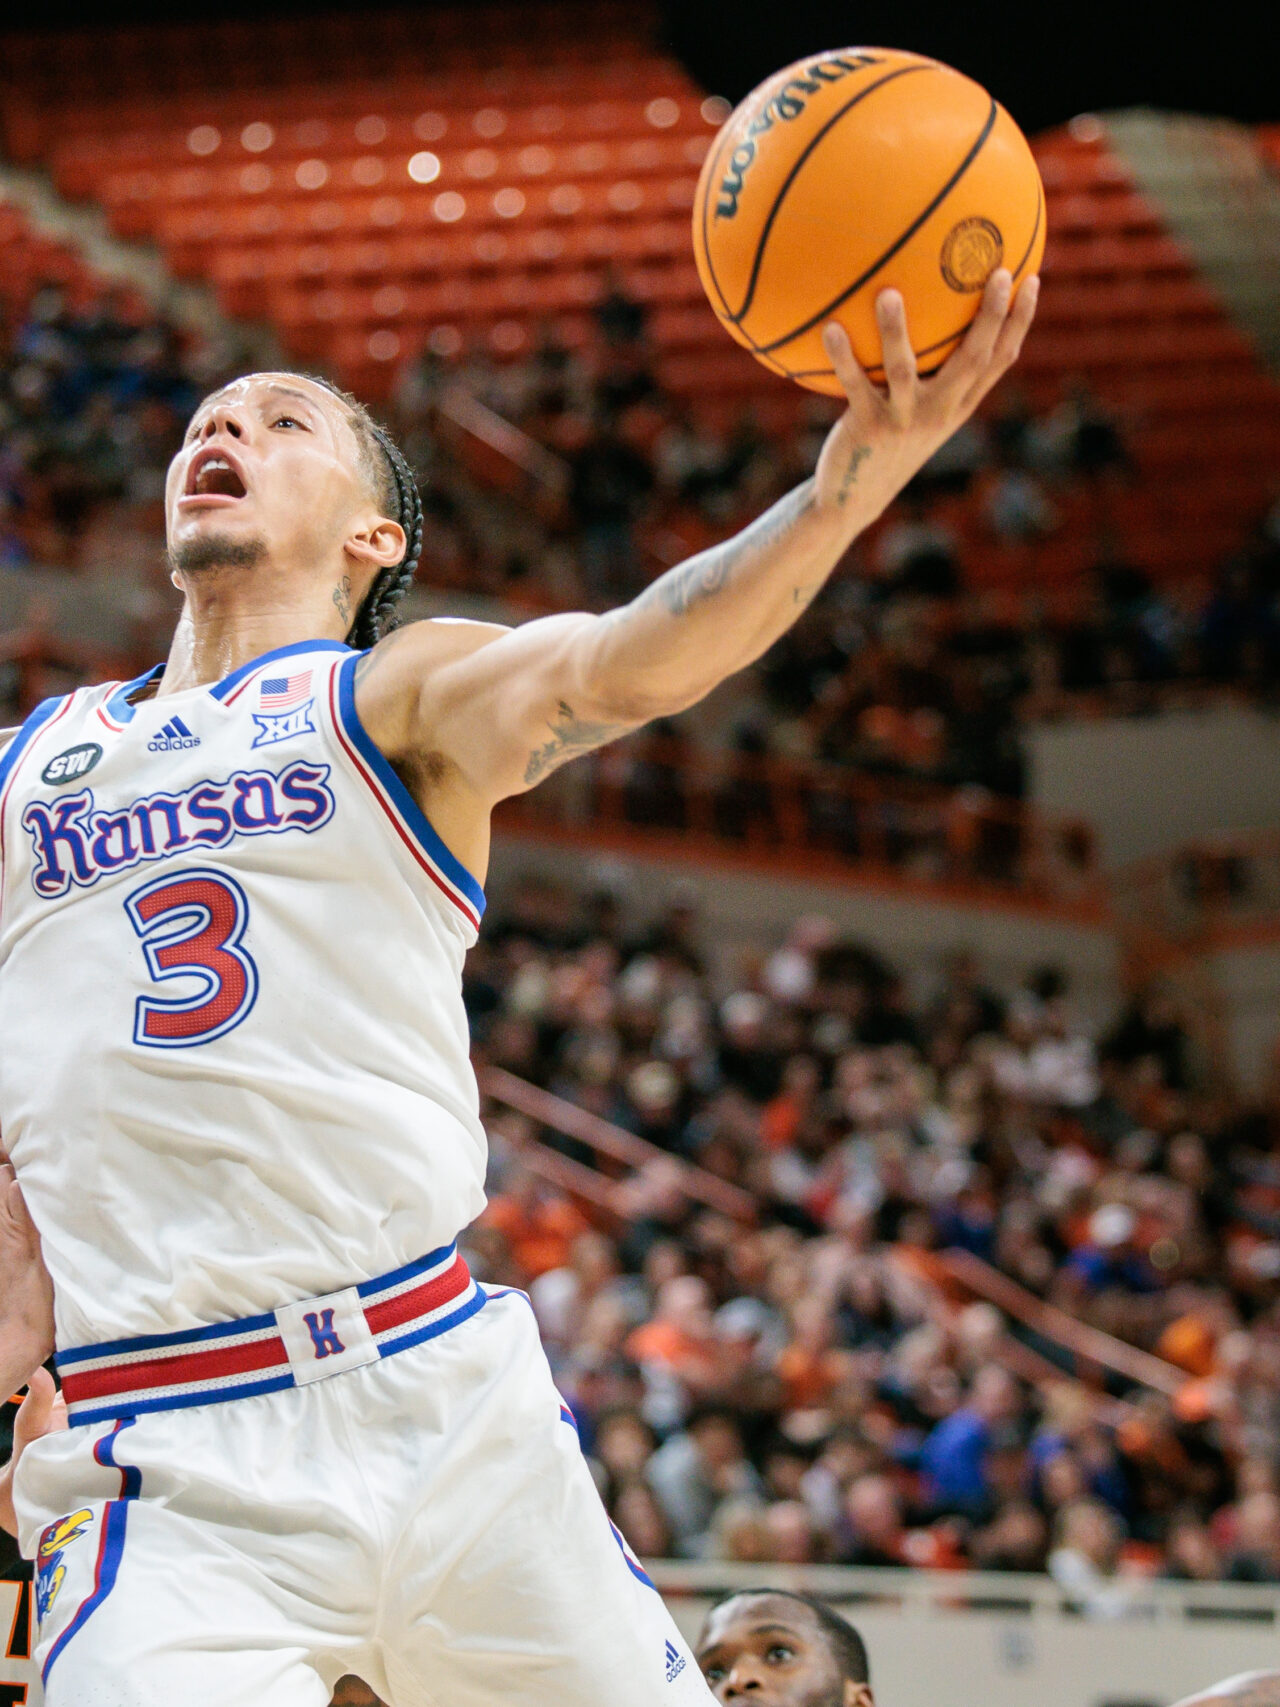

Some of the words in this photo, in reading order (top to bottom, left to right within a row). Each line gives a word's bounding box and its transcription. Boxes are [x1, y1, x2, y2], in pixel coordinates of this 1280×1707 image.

[45, 748, 98, 780] SW
[147, 734, 201, 753] adidas
[21, 760, 336, 899] Kansas
[123, 867, 259, 1049] 3
[302, 1308, 346, 1360] K
